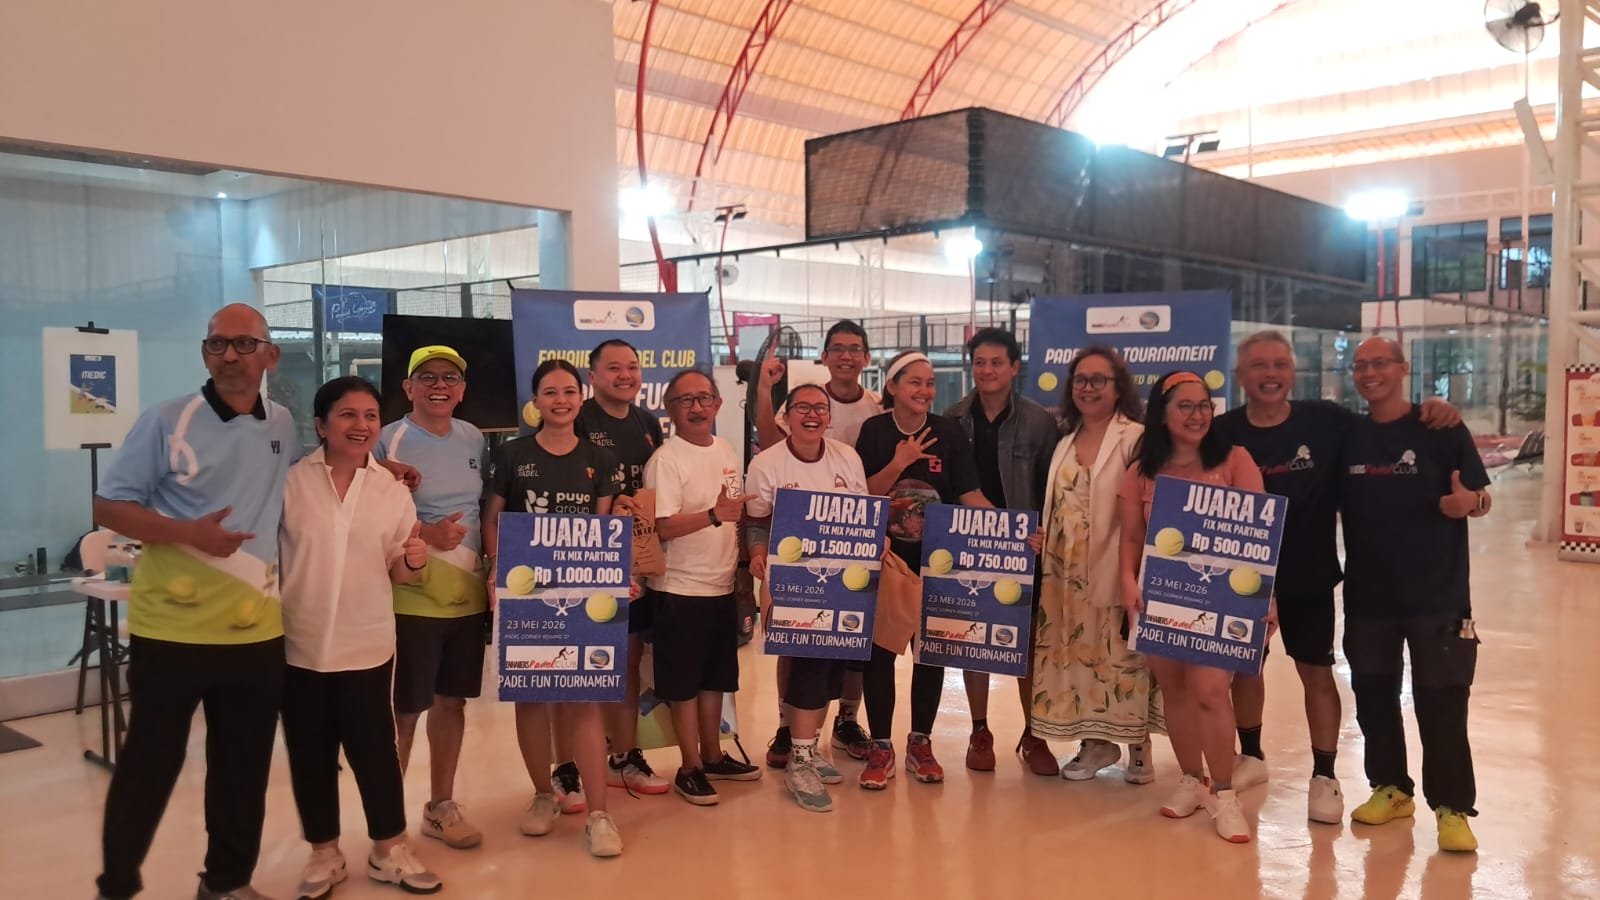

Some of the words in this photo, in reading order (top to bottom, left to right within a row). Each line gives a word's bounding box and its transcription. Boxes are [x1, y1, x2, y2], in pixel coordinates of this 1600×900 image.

[638, 350, 656, 368] DEL
[661, 350, 695, 368] CLUB
[1123, 345, 1217, 363] TOURNAMENT
[81, 370, 107, 379] MEDIC
[1393, 465, 1418, 474] CLUB
[556, 492, 591, 504] puyo
[1183, 484, 1255, 523] JUARA
[1259, 498, 1276, 527] 4
[805, 494, 867, 526] JUARA
[873, 500, 882, 526] 1
[530, 517, 602, 548] JUARA
[608, 519, 622, 548] 2
[819, 525, 831, 534] FIX
[832, 527, 844, 536] MIX
[845, 528, 876, 538] PARTNER
[949, 508, 1010, 538] JUARA
[1015, 513, 1029, 540] 3
[1203, 519, 1216, 530] FIX
[1217, 521, 1232, 534] MIX
[1233, 524, 1269, 540] PARTNER
[801, 538, 816, 556] Rp
[820, 540, 877, 558] 1.500.000
[967, 538, 978, 547] FIX
[980, 539, 992, 548] MIX
[993, 541, 1025, 552] PARTNER
[1192, 533, 1209, 552] Rp
[1213, 536, 1271, 561] 500.000
[553, 552, 566, 561] FIX
[568, 552, 583, 561] MIX
[585, 552, 619, 562] PARTNER
[959, 551, 974, 568] Rp
[978, 553, 1027, 572] 750.000
[534, 567, 552, 585] Rp
[556, 567, 622, 584] 1.000.000
[775, 584, 785, 592] 23
[787, 584, 803, 593] MEI
[805, 585, 825, 595] 2026
[1150, 576, 1161, 586] 23
[1165, 579, 1182, 590] MEI
[1184, 583, 1208, 595] 2026
[928, 594, 938, 603] 23
[939, 595, 955, 604] MEI
[956, 597, 976, 607] 2026
[507, 620, 519, 630] 23
[521, 620, 539, 629] MEI
[542, 620, 566, 630] 2026
[765, 632, 789, 644] PADEL
[792, 633, 809, 645] FUN
[811, 634, 868, 648] TOURNAMENT
[1137, 625, 1165, 643] PADEL
[1168, 632, 1187, 647] FUN
[1190, 637, 1257, 661] TOURNAMENT
[919, 640, 944, 654] PADEL
[946, 644, 963, 656] FUN
[965, 646, 1023, 664] TOURNAMENT
[498, 674, 528, 688] PADEL
[531, 675, 550, 688] FUN
[553, 675, 620, 688] TOURNAMENT
